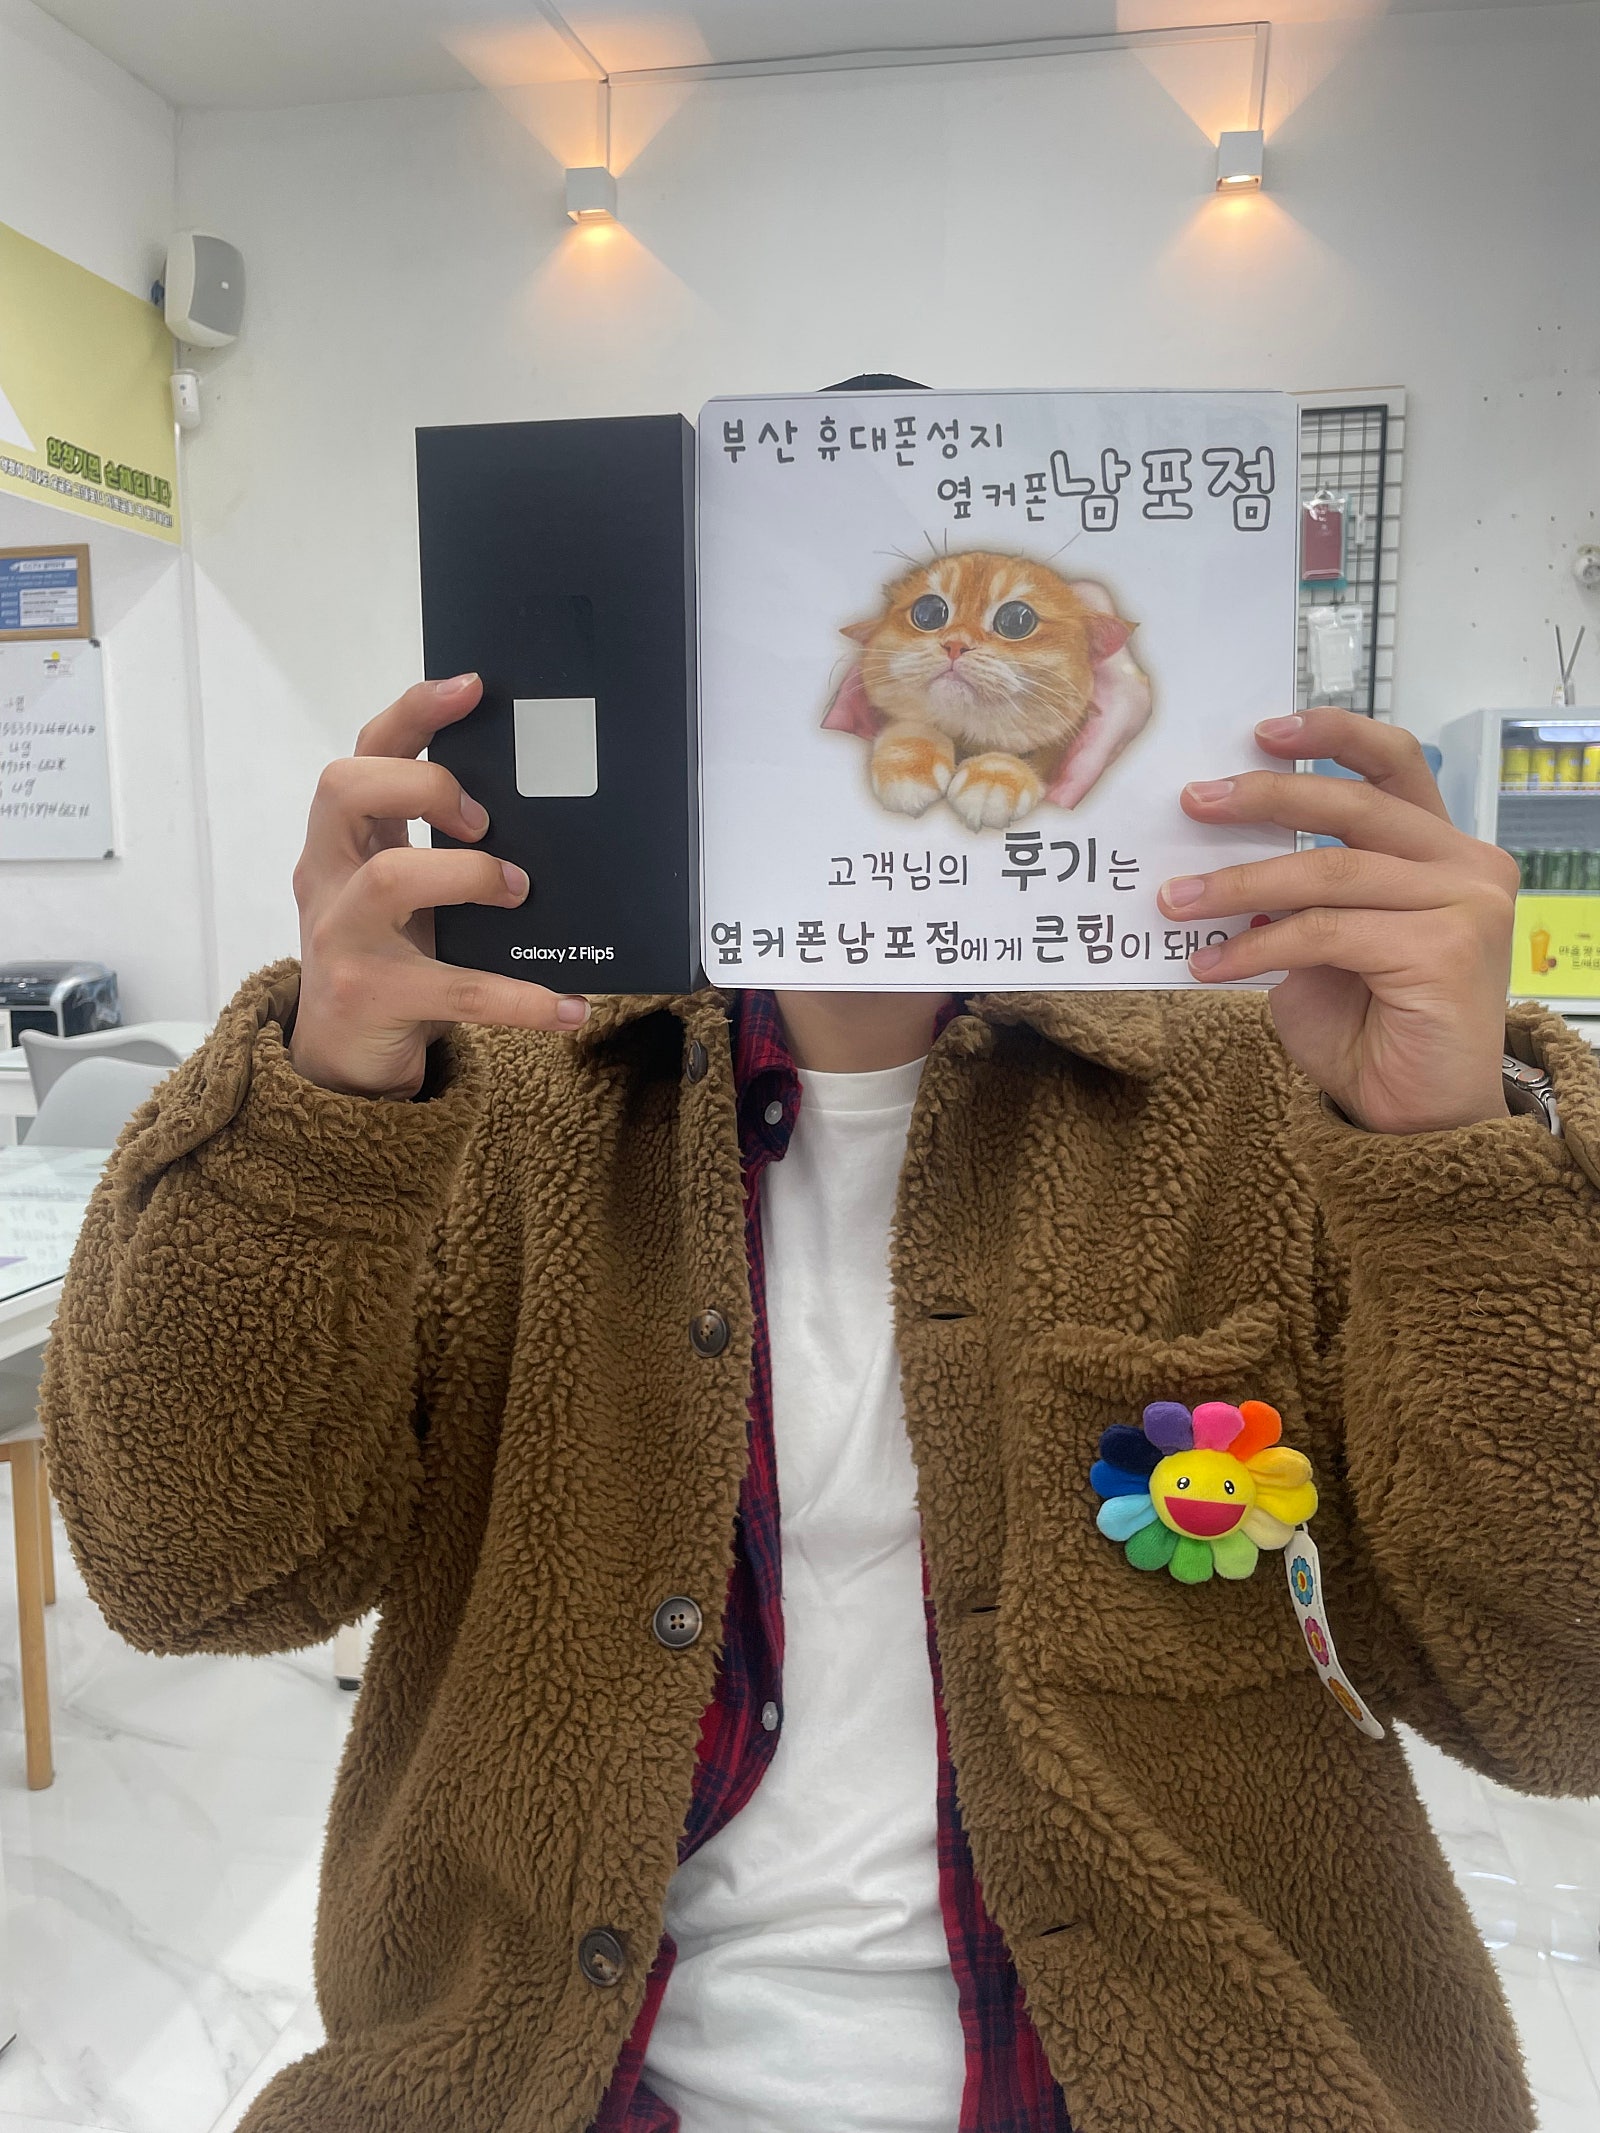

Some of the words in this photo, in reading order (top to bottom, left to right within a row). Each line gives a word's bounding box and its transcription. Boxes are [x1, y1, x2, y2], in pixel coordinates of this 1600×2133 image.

[723, 419, 799, 464] 부산
[817, 415, 1003, 467] 휴대폰성지
[104, 460, 171, 508] 손해입니다
[937, 473, 1047, 522] 옆커폰
[1049, 446, 1276, 533] 남포점
[828, 850, 968, 891] 고객님의
[1001, 830, 1140, 892] 후기는
[510, 946, 566, 963] Galaxy
[568, 946, 578, 960] Z
[579, 945, 615, 965] Flip5
[1032, 914, 1150, 965] 큰힘이
